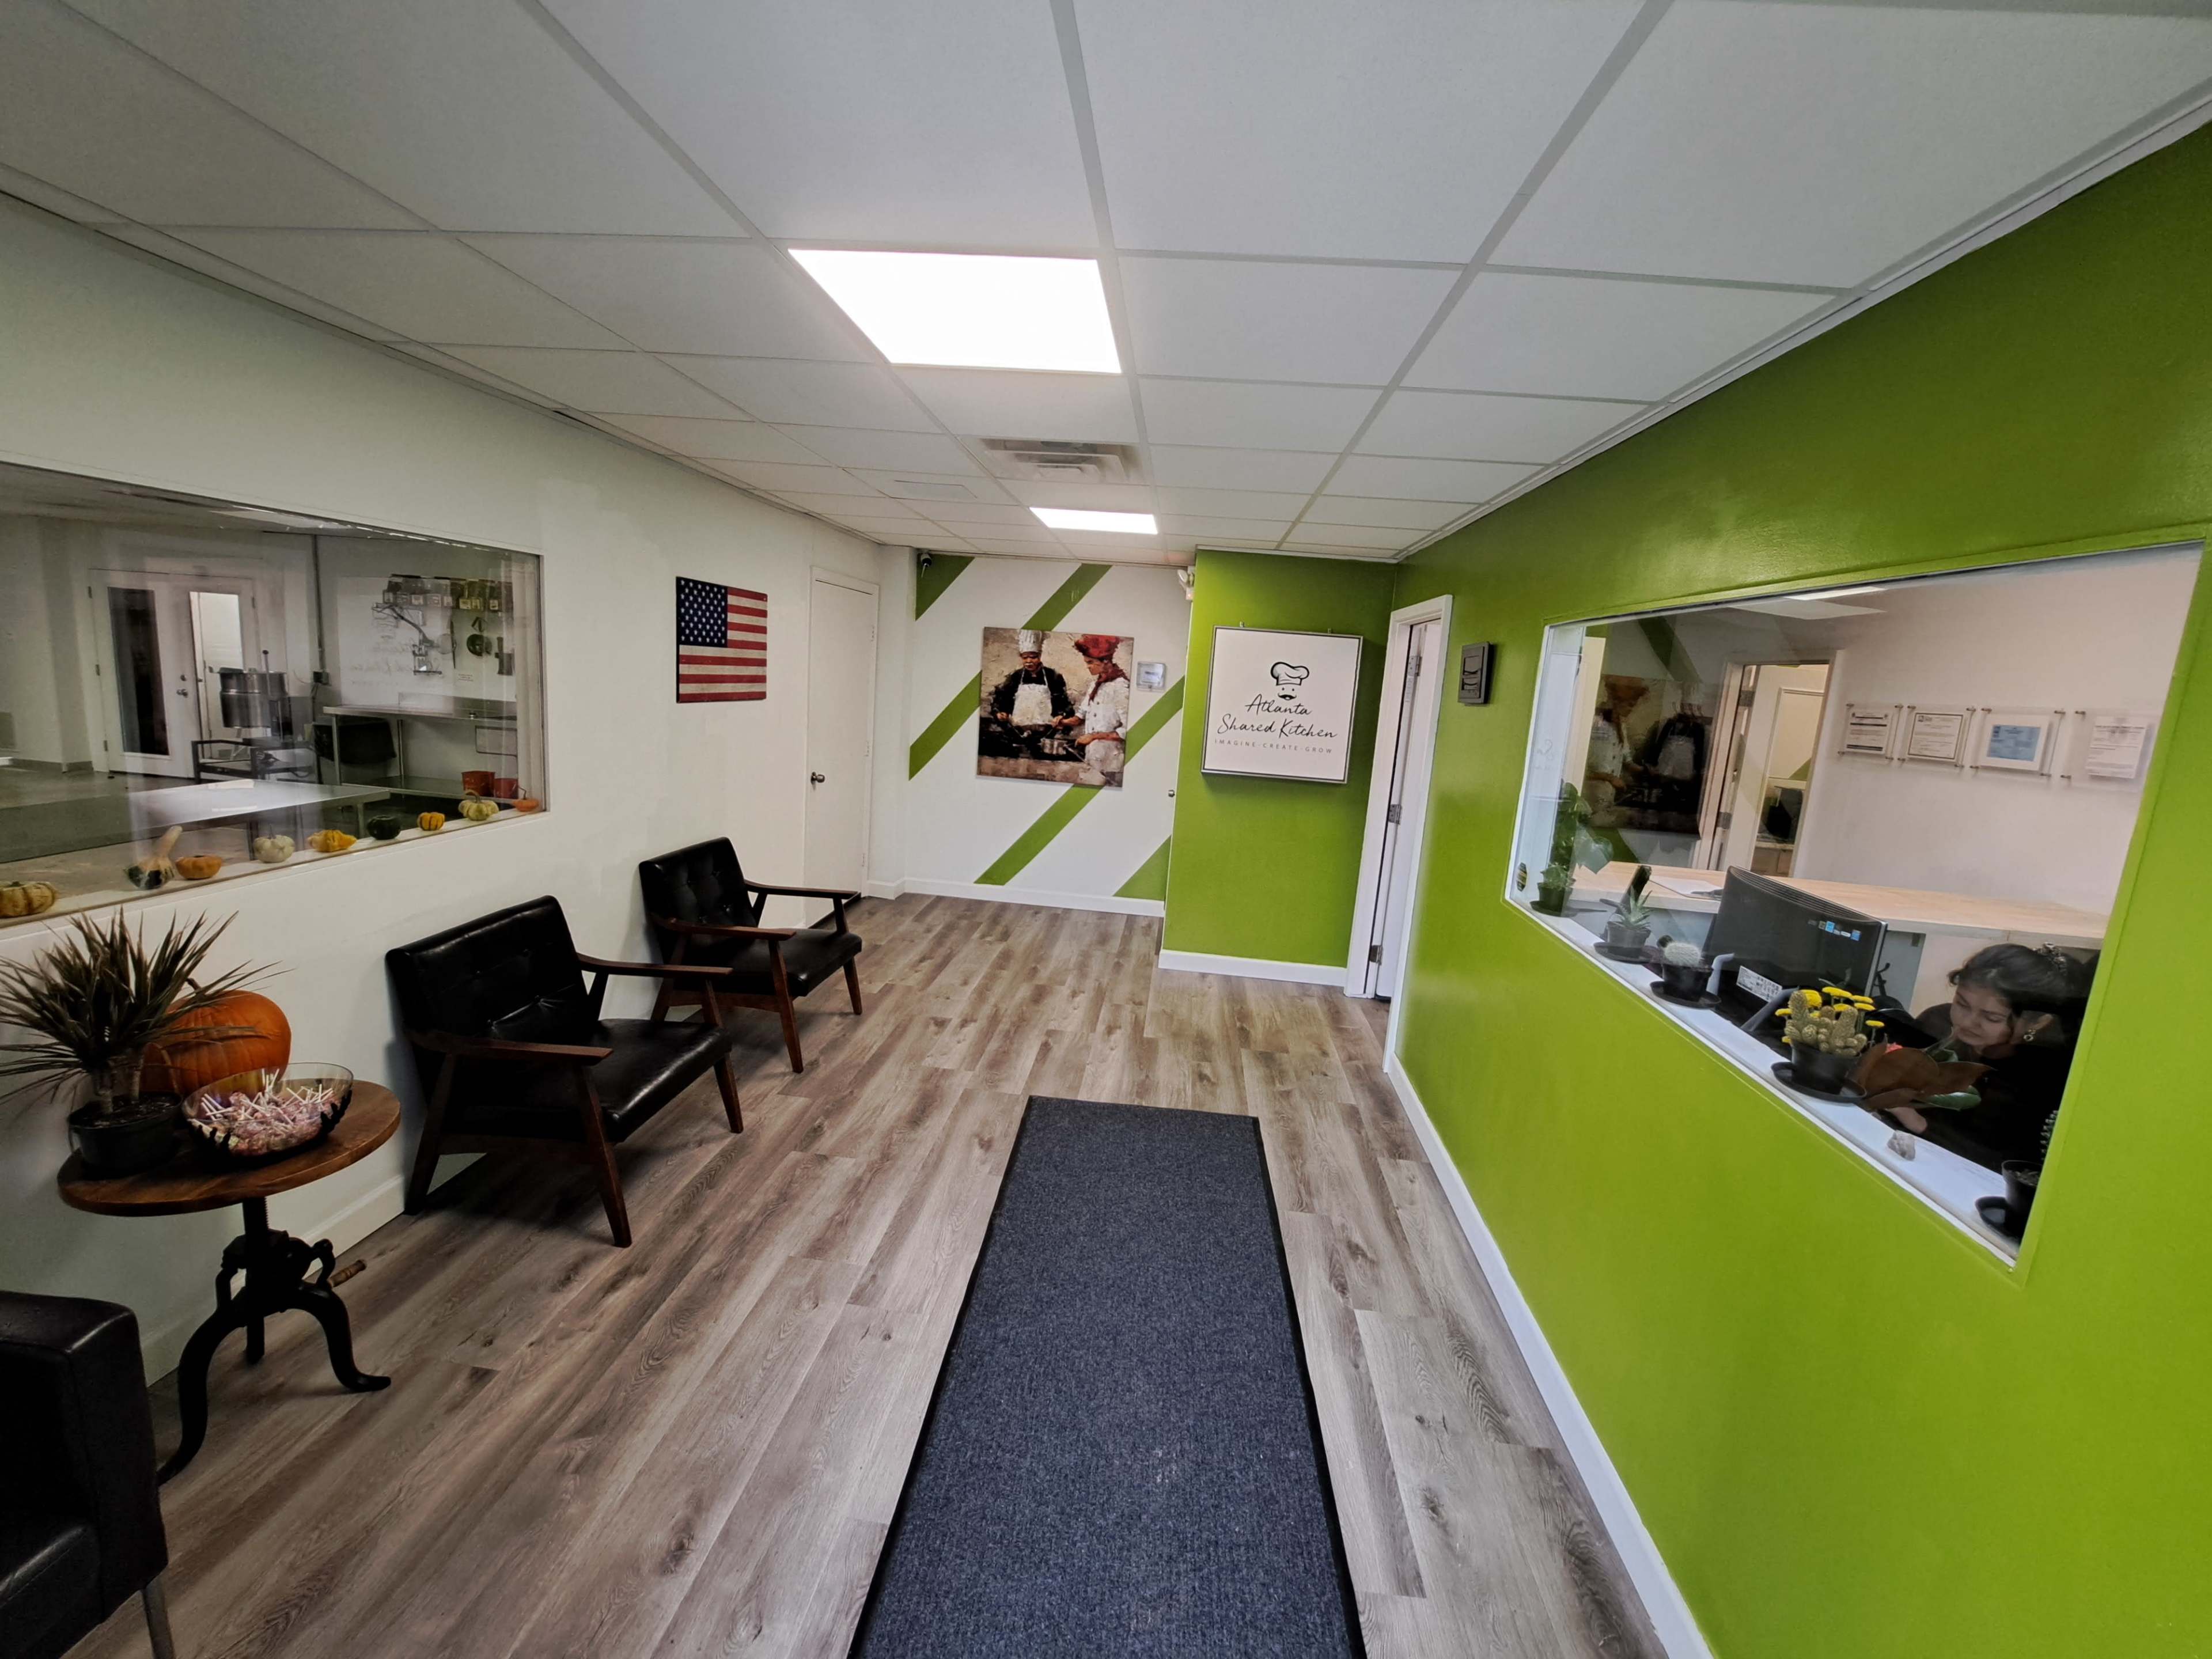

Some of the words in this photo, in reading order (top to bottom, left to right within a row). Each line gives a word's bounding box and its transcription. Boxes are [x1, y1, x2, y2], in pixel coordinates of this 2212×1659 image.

[1245, 694, 1312, 715] Atlanta
[1217, 713, 1276, 734] Shared
[1279, 718, 1338, 738] Kitchen
